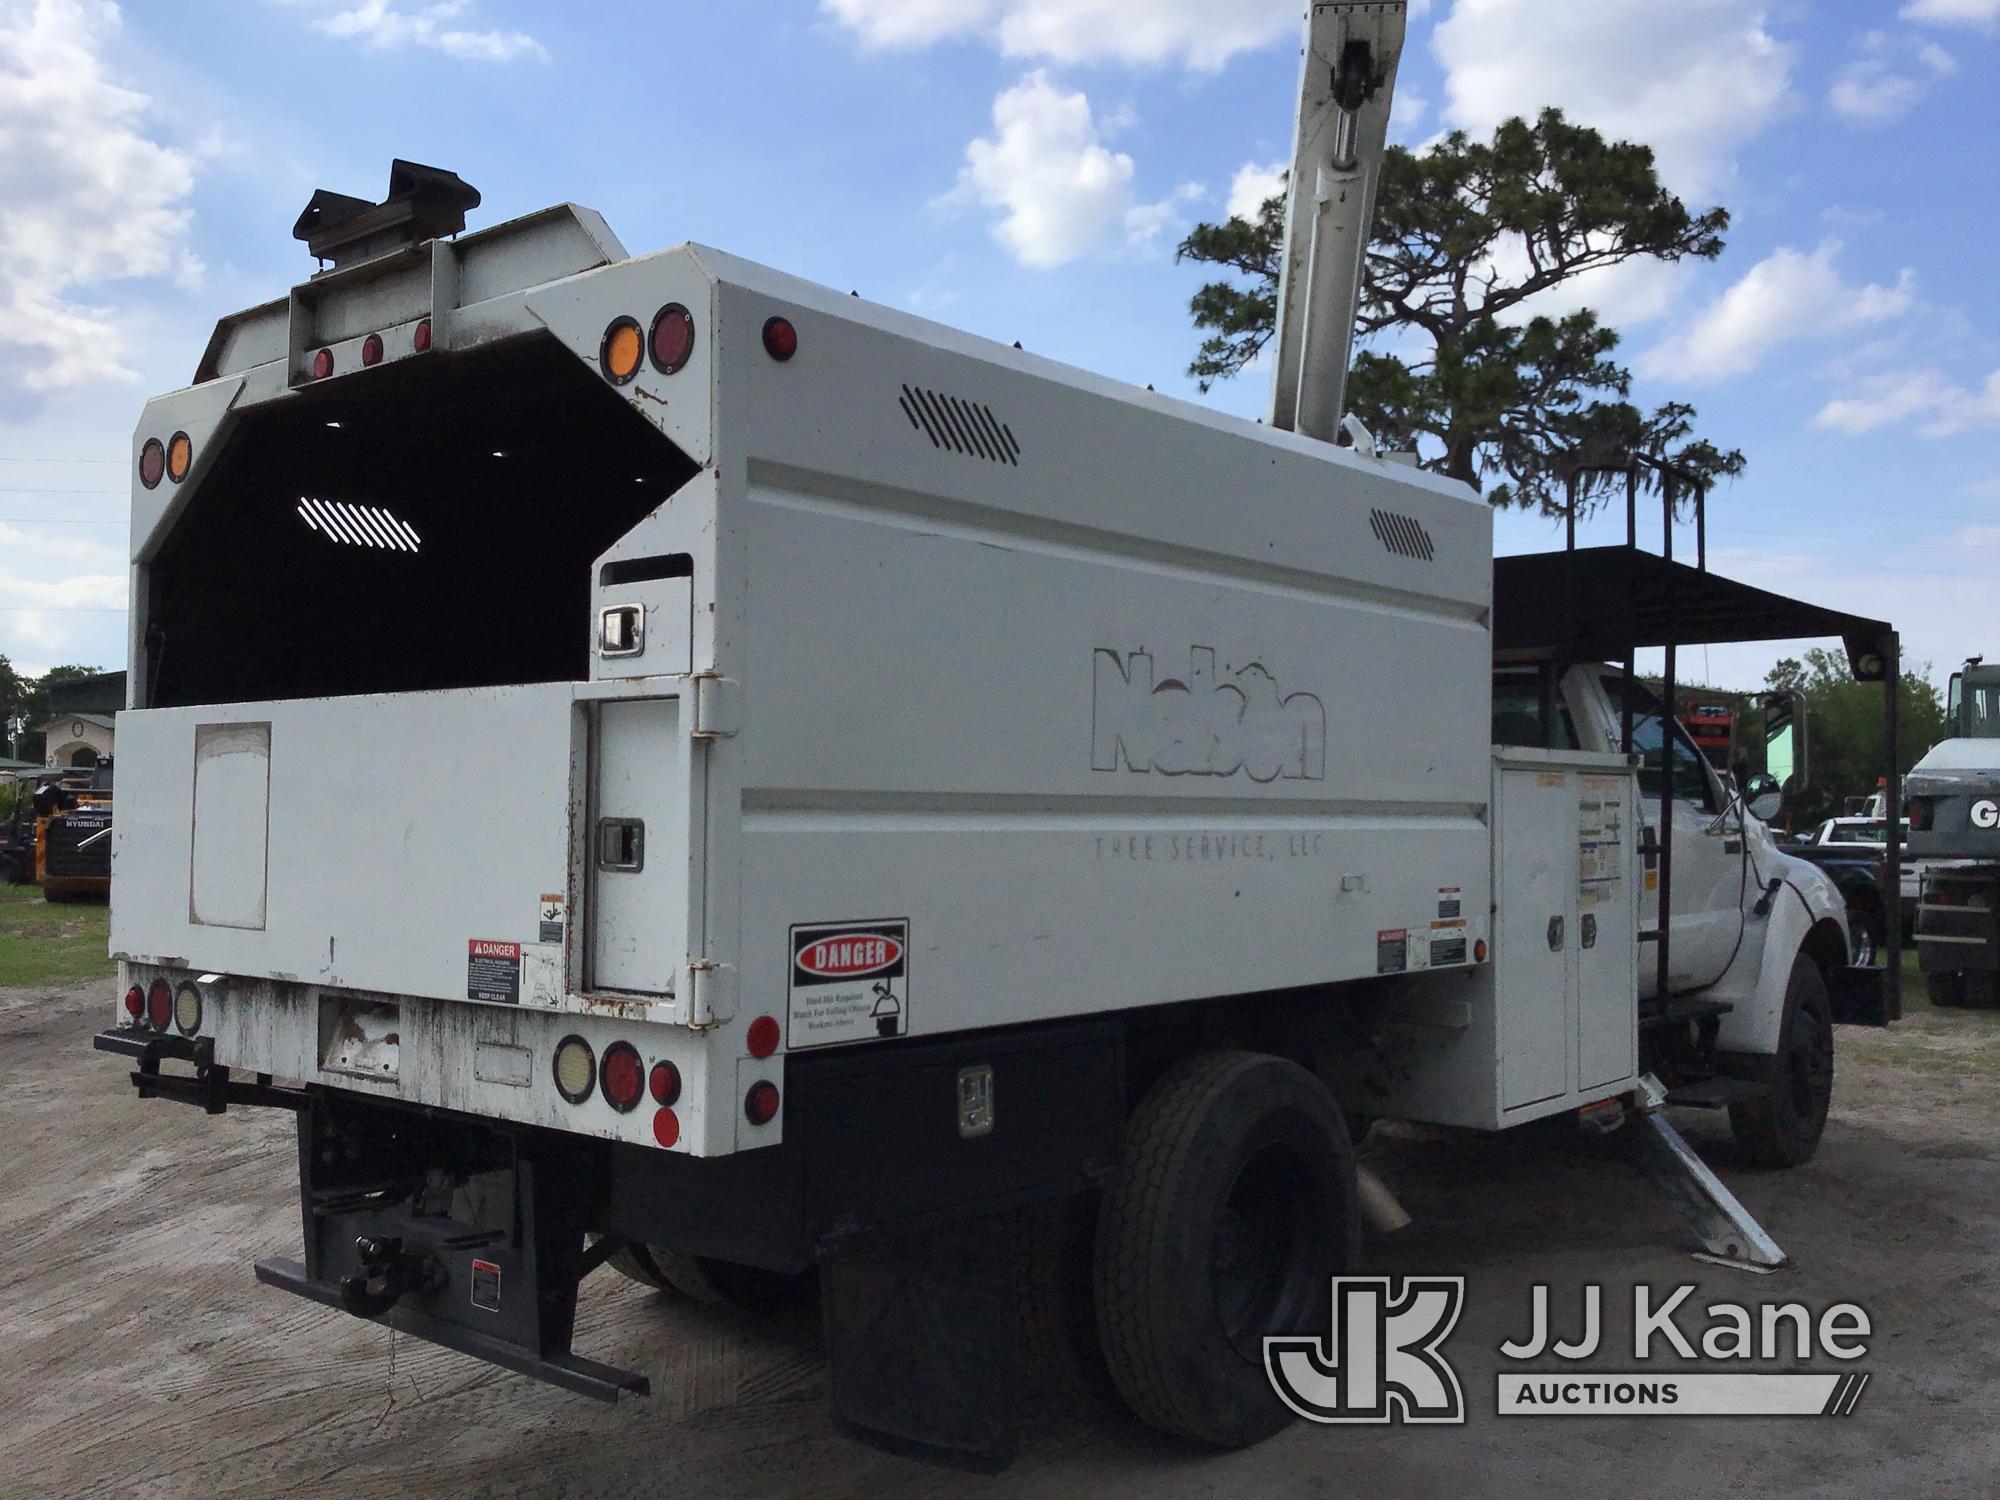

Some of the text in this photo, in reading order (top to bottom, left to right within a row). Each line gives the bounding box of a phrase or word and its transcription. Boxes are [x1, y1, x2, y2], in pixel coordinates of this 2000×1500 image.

[66, 820, 104, 828] HYUNDAI
[1971, 800, 2000, 829] G
[1095, 836, 1154, 861] TREE
[483, 944, 515, 957] DANGER
[816, 941, 887, 969] DANGER
